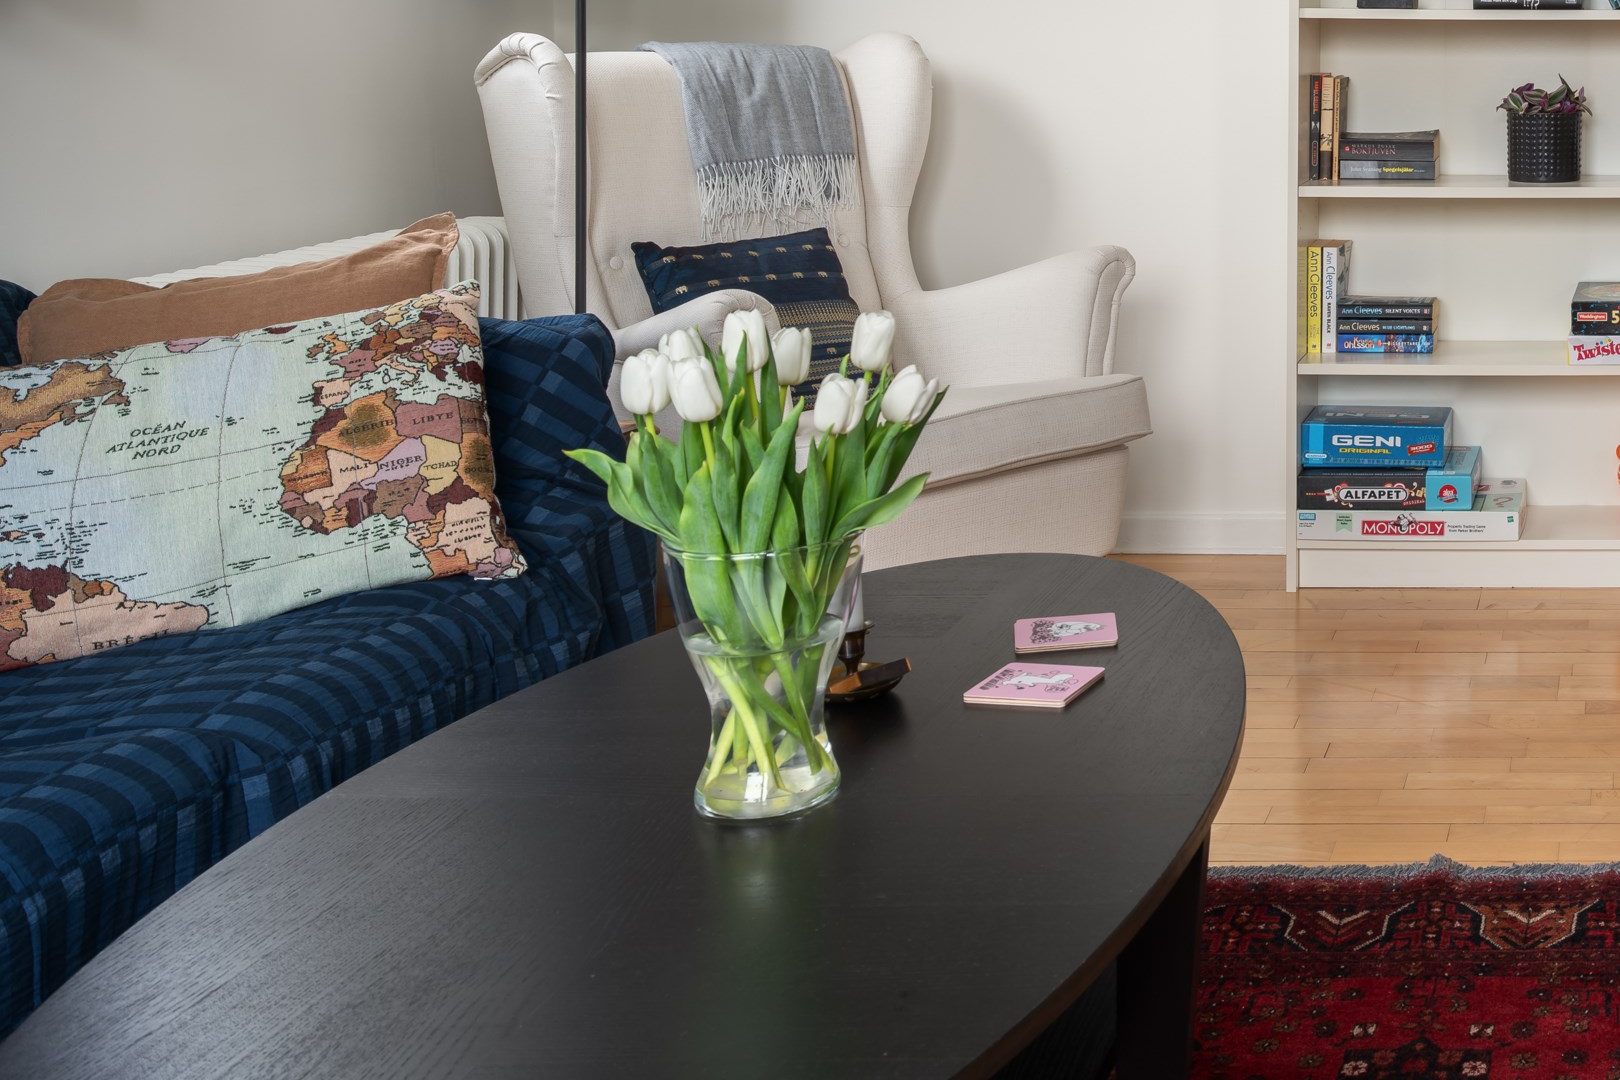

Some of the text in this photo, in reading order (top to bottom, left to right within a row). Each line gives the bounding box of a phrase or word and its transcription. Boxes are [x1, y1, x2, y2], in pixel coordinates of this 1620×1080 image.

[1351, 147, 1396, 155] BOKTJUVEN
[1310, 251, 1320, 318] Ann Cleeves
[1325, 265, 1336, 300] Cleeves
[1354, 306, 1383, 315] Cleeves
[1351, 322, 1380, 331] Cleeves
[412, 412, 454, 425] LIBYE
[130, 421, 186, 437] OCÉAN
[106, 427, 210, 454] ATLANTIQUE
[1332, 434, 1402, 447] GENI
[132, 444, 181, 460] NORD
[339, 462, 369, 474] MALI
[379, 455, 424, 470] NIGER
[423, 460, 459, 471] TCHAD
[1344, 490, 1402, 500] ALFAPET
[1442, 489, 1454, 497] alga
[1402, 499, 1425, 507] ORIGINAL
[1363, 522, 1444, 535] MONOPOLY
